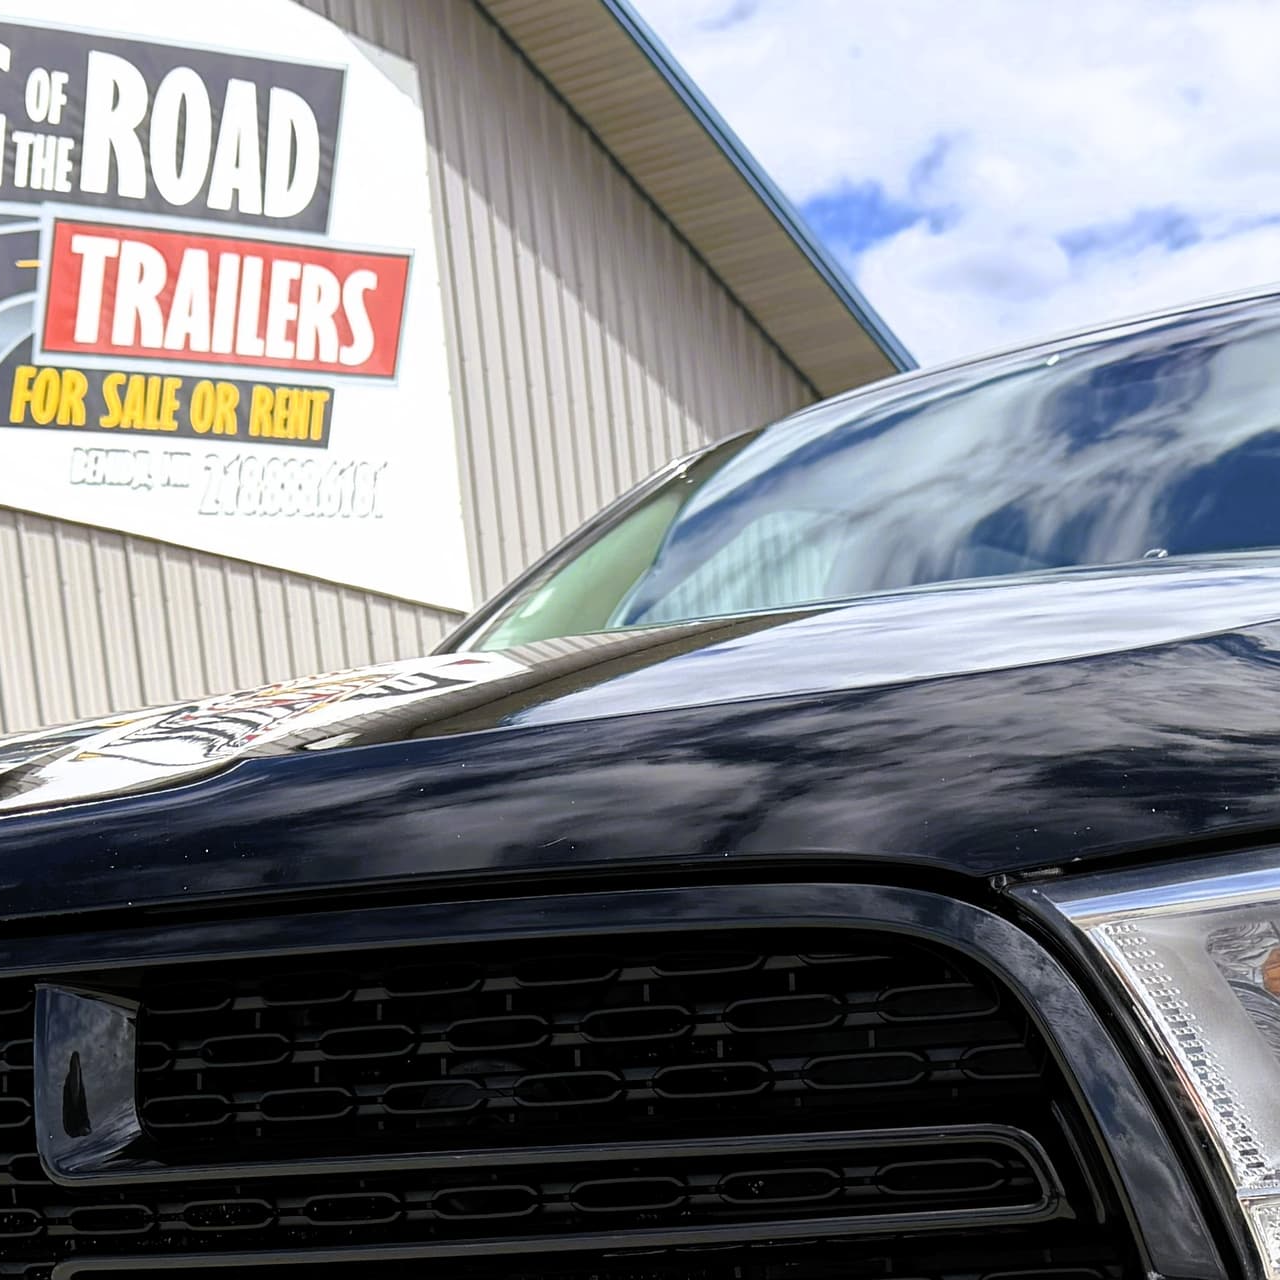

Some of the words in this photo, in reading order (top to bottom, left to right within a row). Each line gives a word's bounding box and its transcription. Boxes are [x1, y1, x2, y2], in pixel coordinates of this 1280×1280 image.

[25, 67, 69, 125] OF
[11, 130, 74, 193] THE
[80, 50, 321, 219] ROAD
[71, 234, 378, 367] TRAILERS
[9, 365, 88, 426] FOR
[99, 372, 183, 432] SALE
[190, 380, 241, 435] OR
[249, 384, 331, 441] RENT
